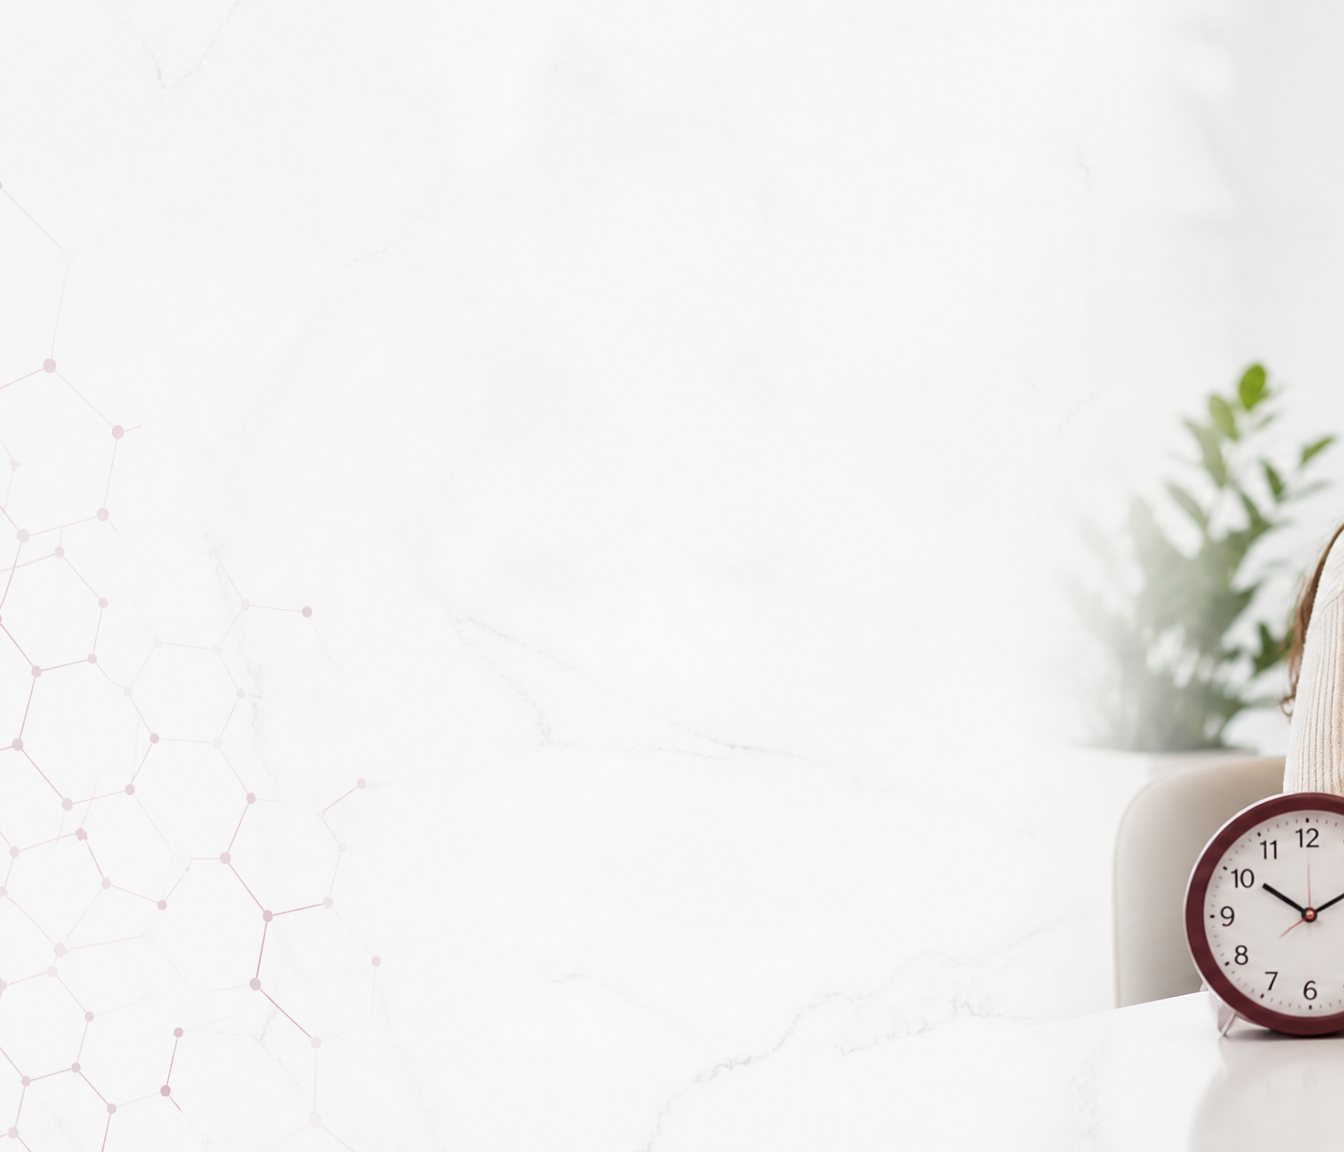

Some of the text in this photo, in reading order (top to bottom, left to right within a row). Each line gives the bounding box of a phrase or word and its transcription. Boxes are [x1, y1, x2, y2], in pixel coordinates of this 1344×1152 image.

[1295, 828, 1320, 849] 12
[1259, 840, 1278, 860] 11
[1231, 868, 1255, 889] 10
[1220, 906, 1235, 927] 9
[1234, 945, 1249, 965] 8
[1264, 971, 1279, 991] 7
[1303, 980, 1318, 1000] 6
